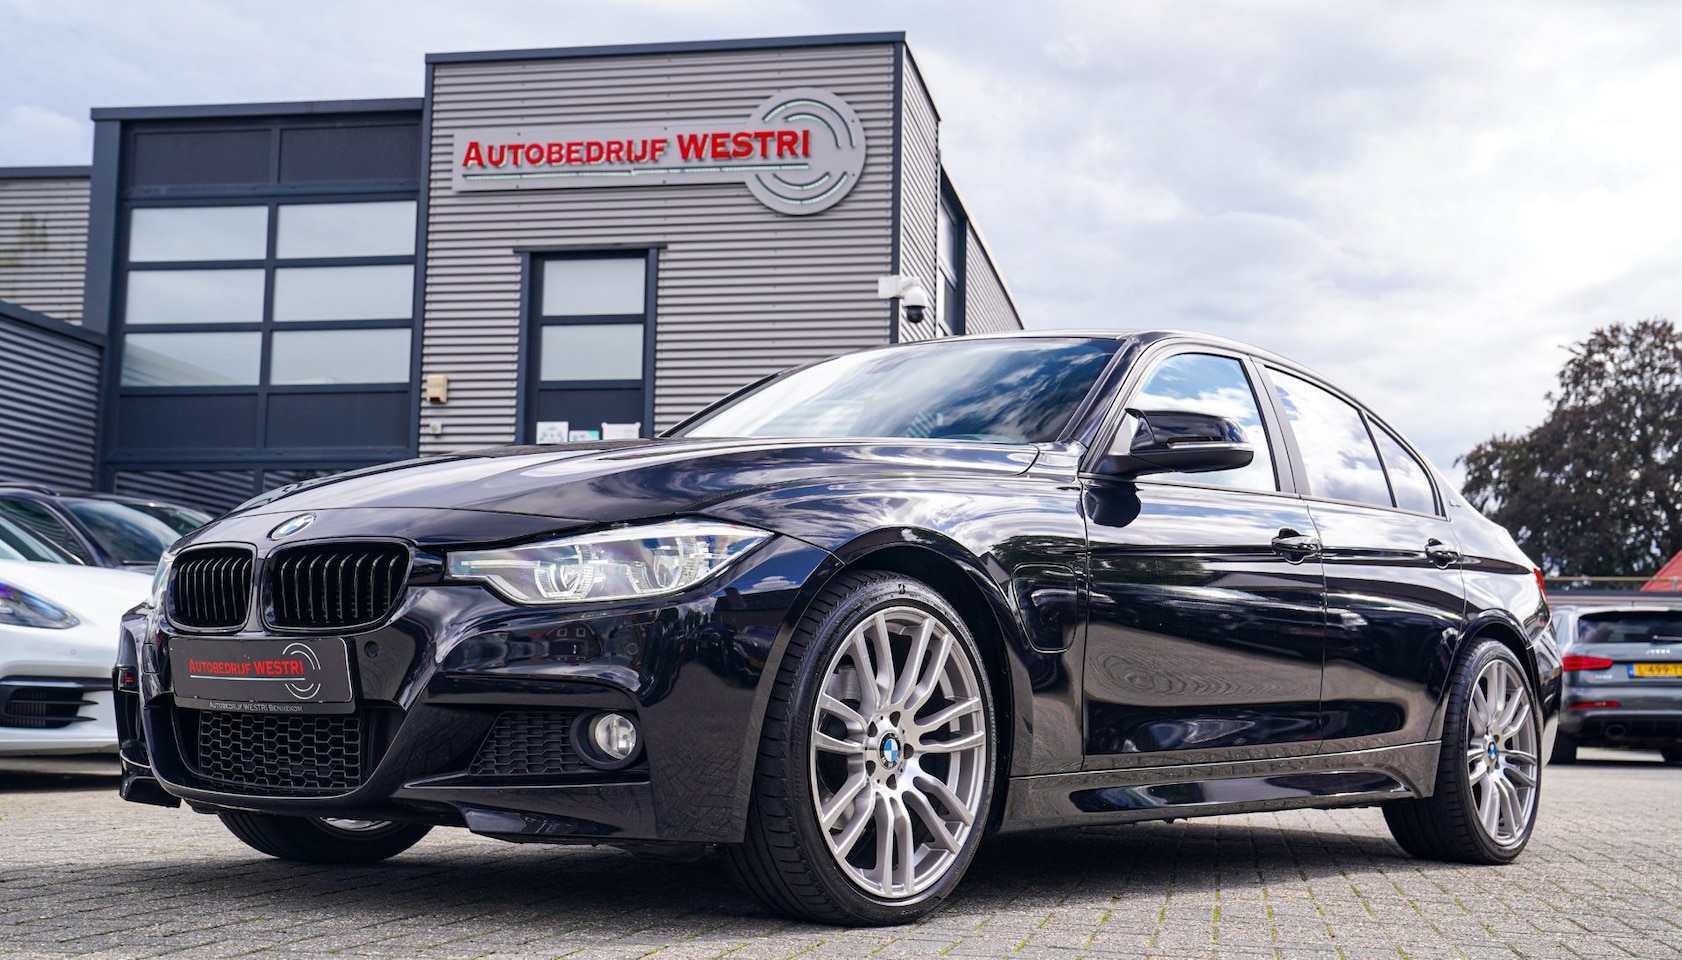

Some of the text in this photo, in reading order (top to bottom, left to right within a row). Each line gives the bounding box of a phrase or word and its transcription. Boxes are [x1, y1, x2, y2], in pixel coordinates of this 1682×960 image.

[462, 129, 811, 168] AUTOBEDRIJF WESTRI
[189, 659, 305, 675] AUTOBEDRIJF WESTRI
[1638, 664, 1682, 675] L-499-T
[243, 702, 269, 711] WESTRI
